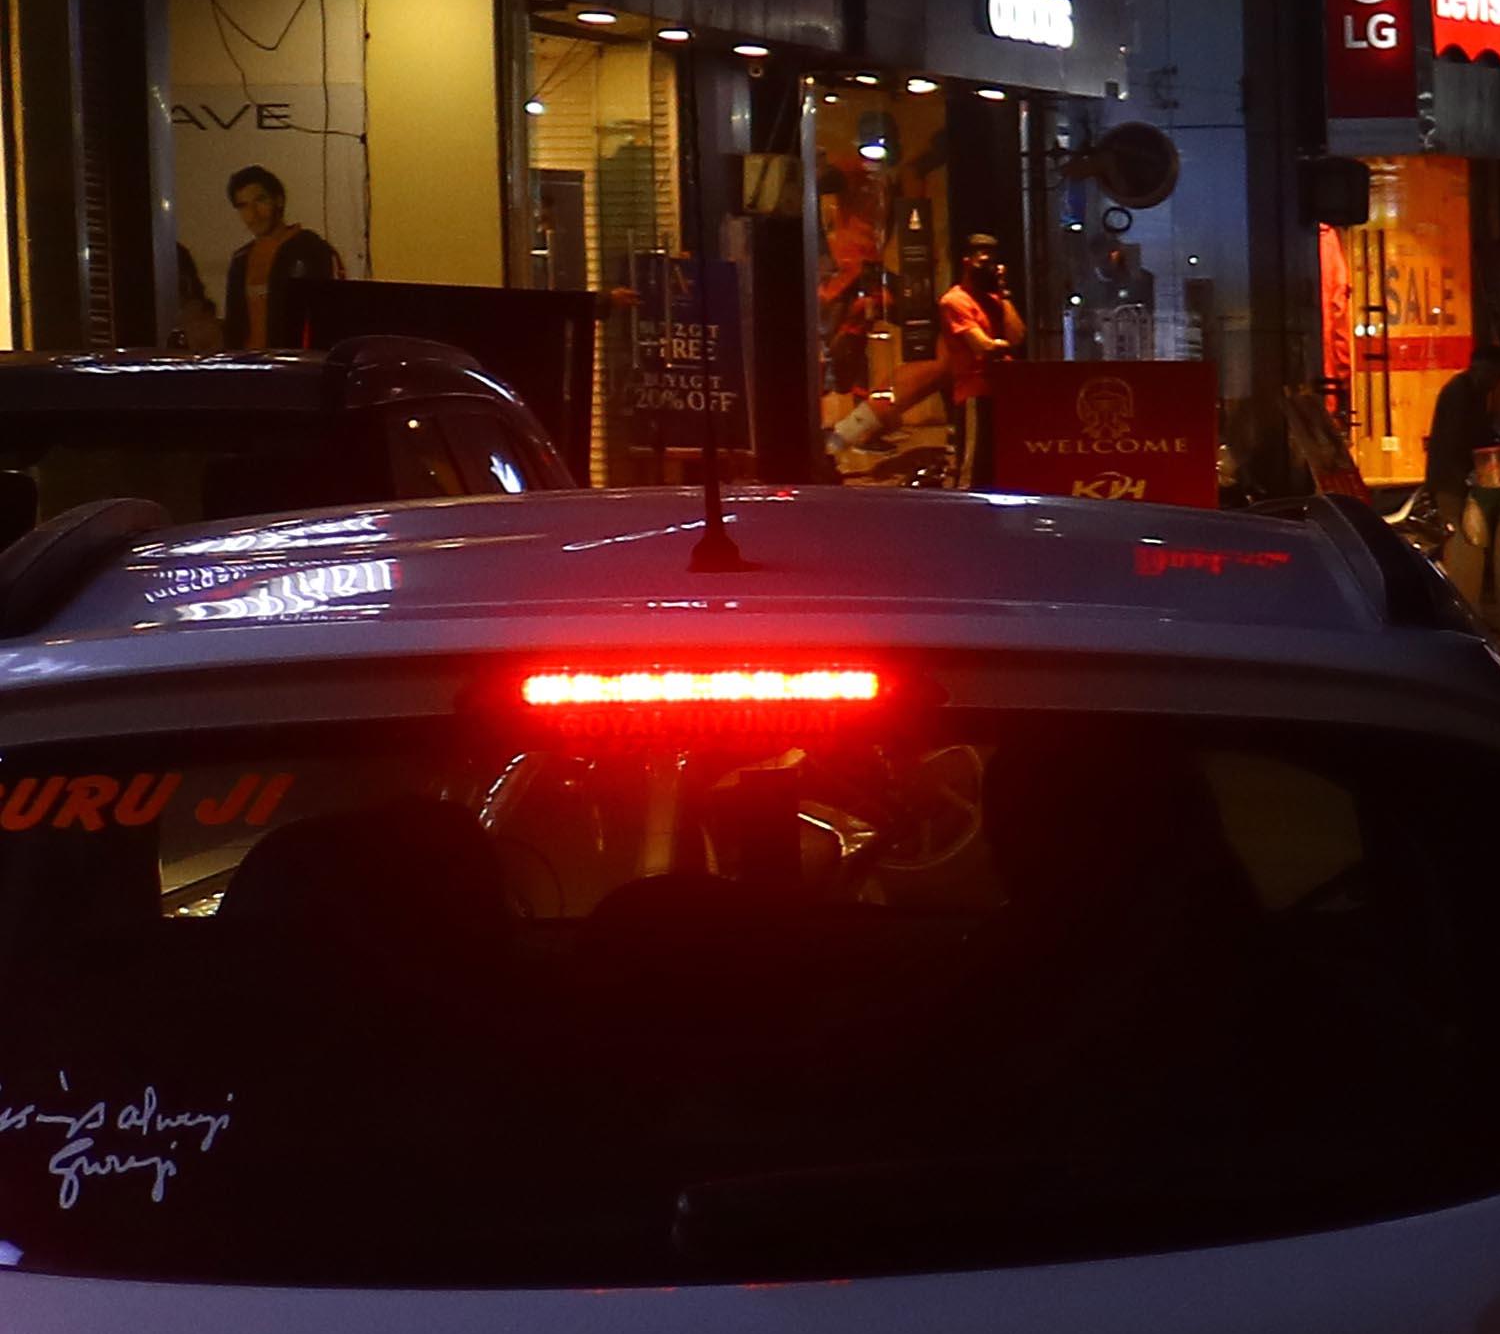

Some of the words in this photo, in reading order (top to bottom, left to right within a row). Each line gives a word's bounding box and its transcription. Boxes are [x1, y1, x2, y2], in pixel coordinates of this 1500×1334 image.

[1344, 13, 1398, 50] LG
[1023, 436, 1189, 455] WELCOME
[0, 772, 182, 832] URU
[195, 772, 295, 827] JI
